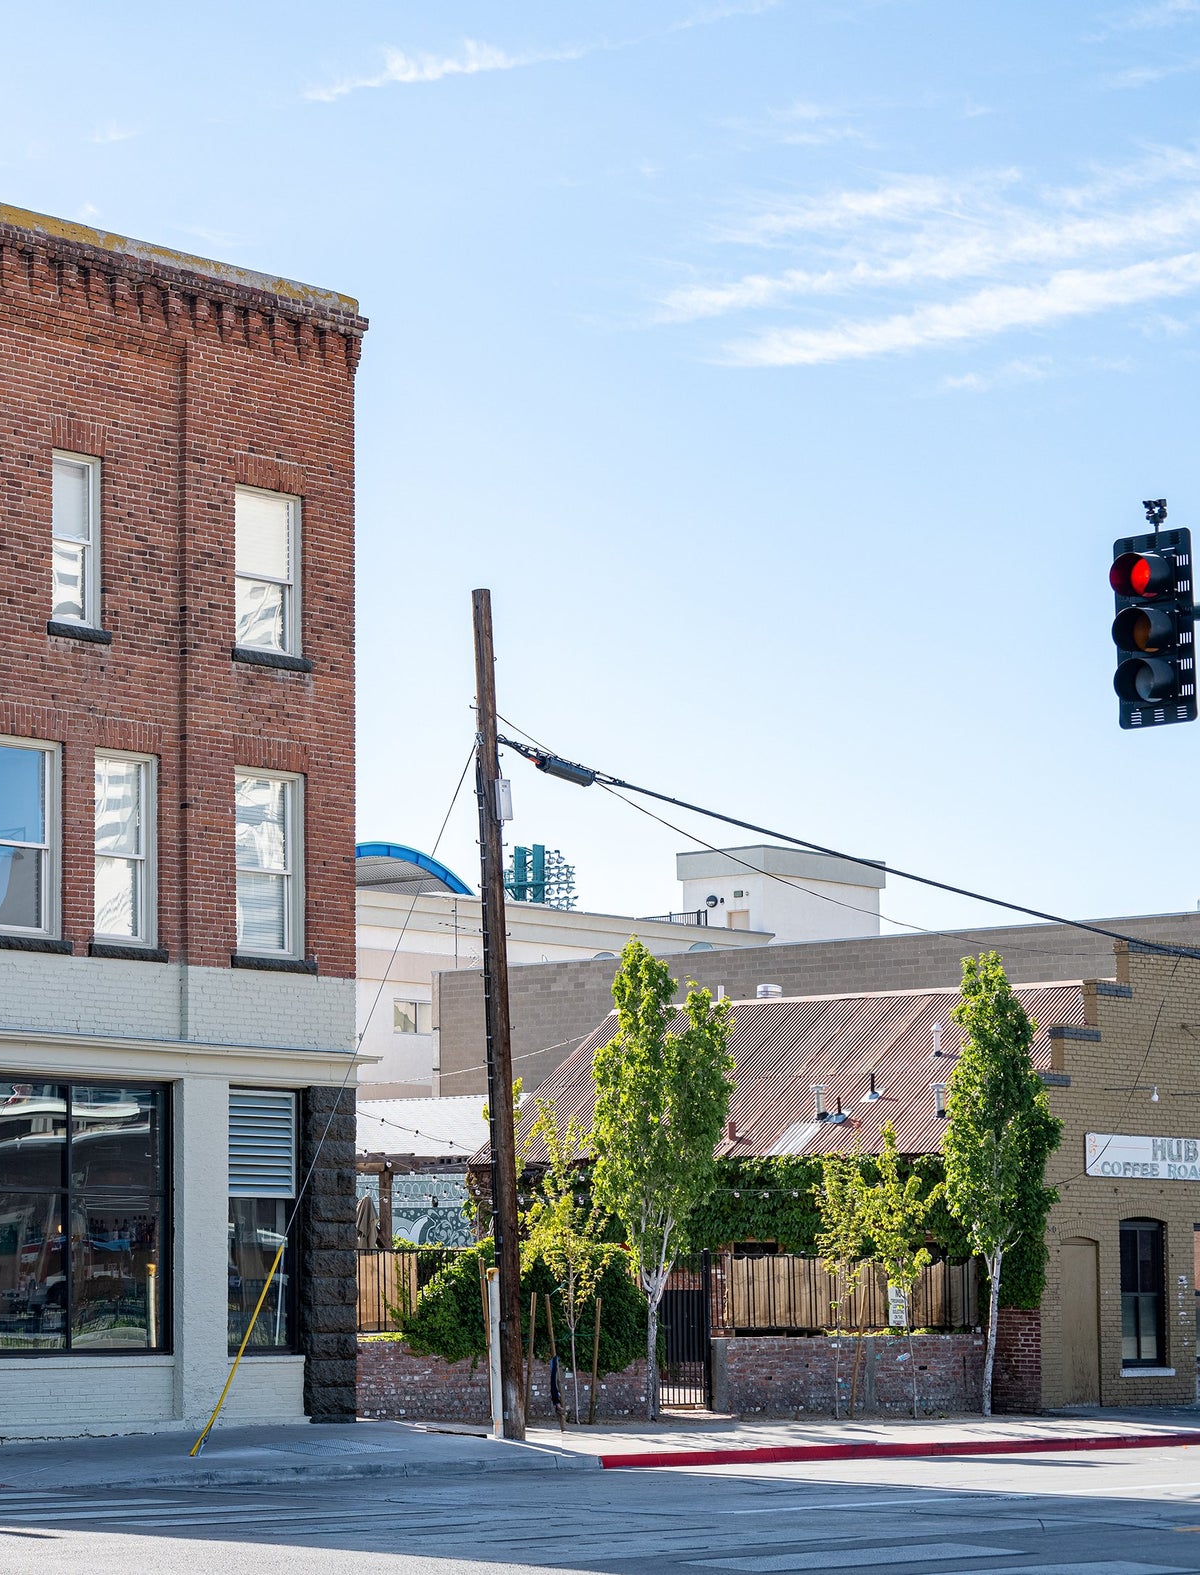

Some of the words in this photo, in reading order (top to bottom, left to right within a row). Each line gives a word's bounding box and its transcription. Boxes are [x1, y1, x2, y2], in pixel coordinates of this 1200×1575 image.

[1151, 1138, 1199, 1163] HUB
[1100, 1160, 1160, 1177] COFFEE
[1167, 1163, 1200, 1179] ROA
